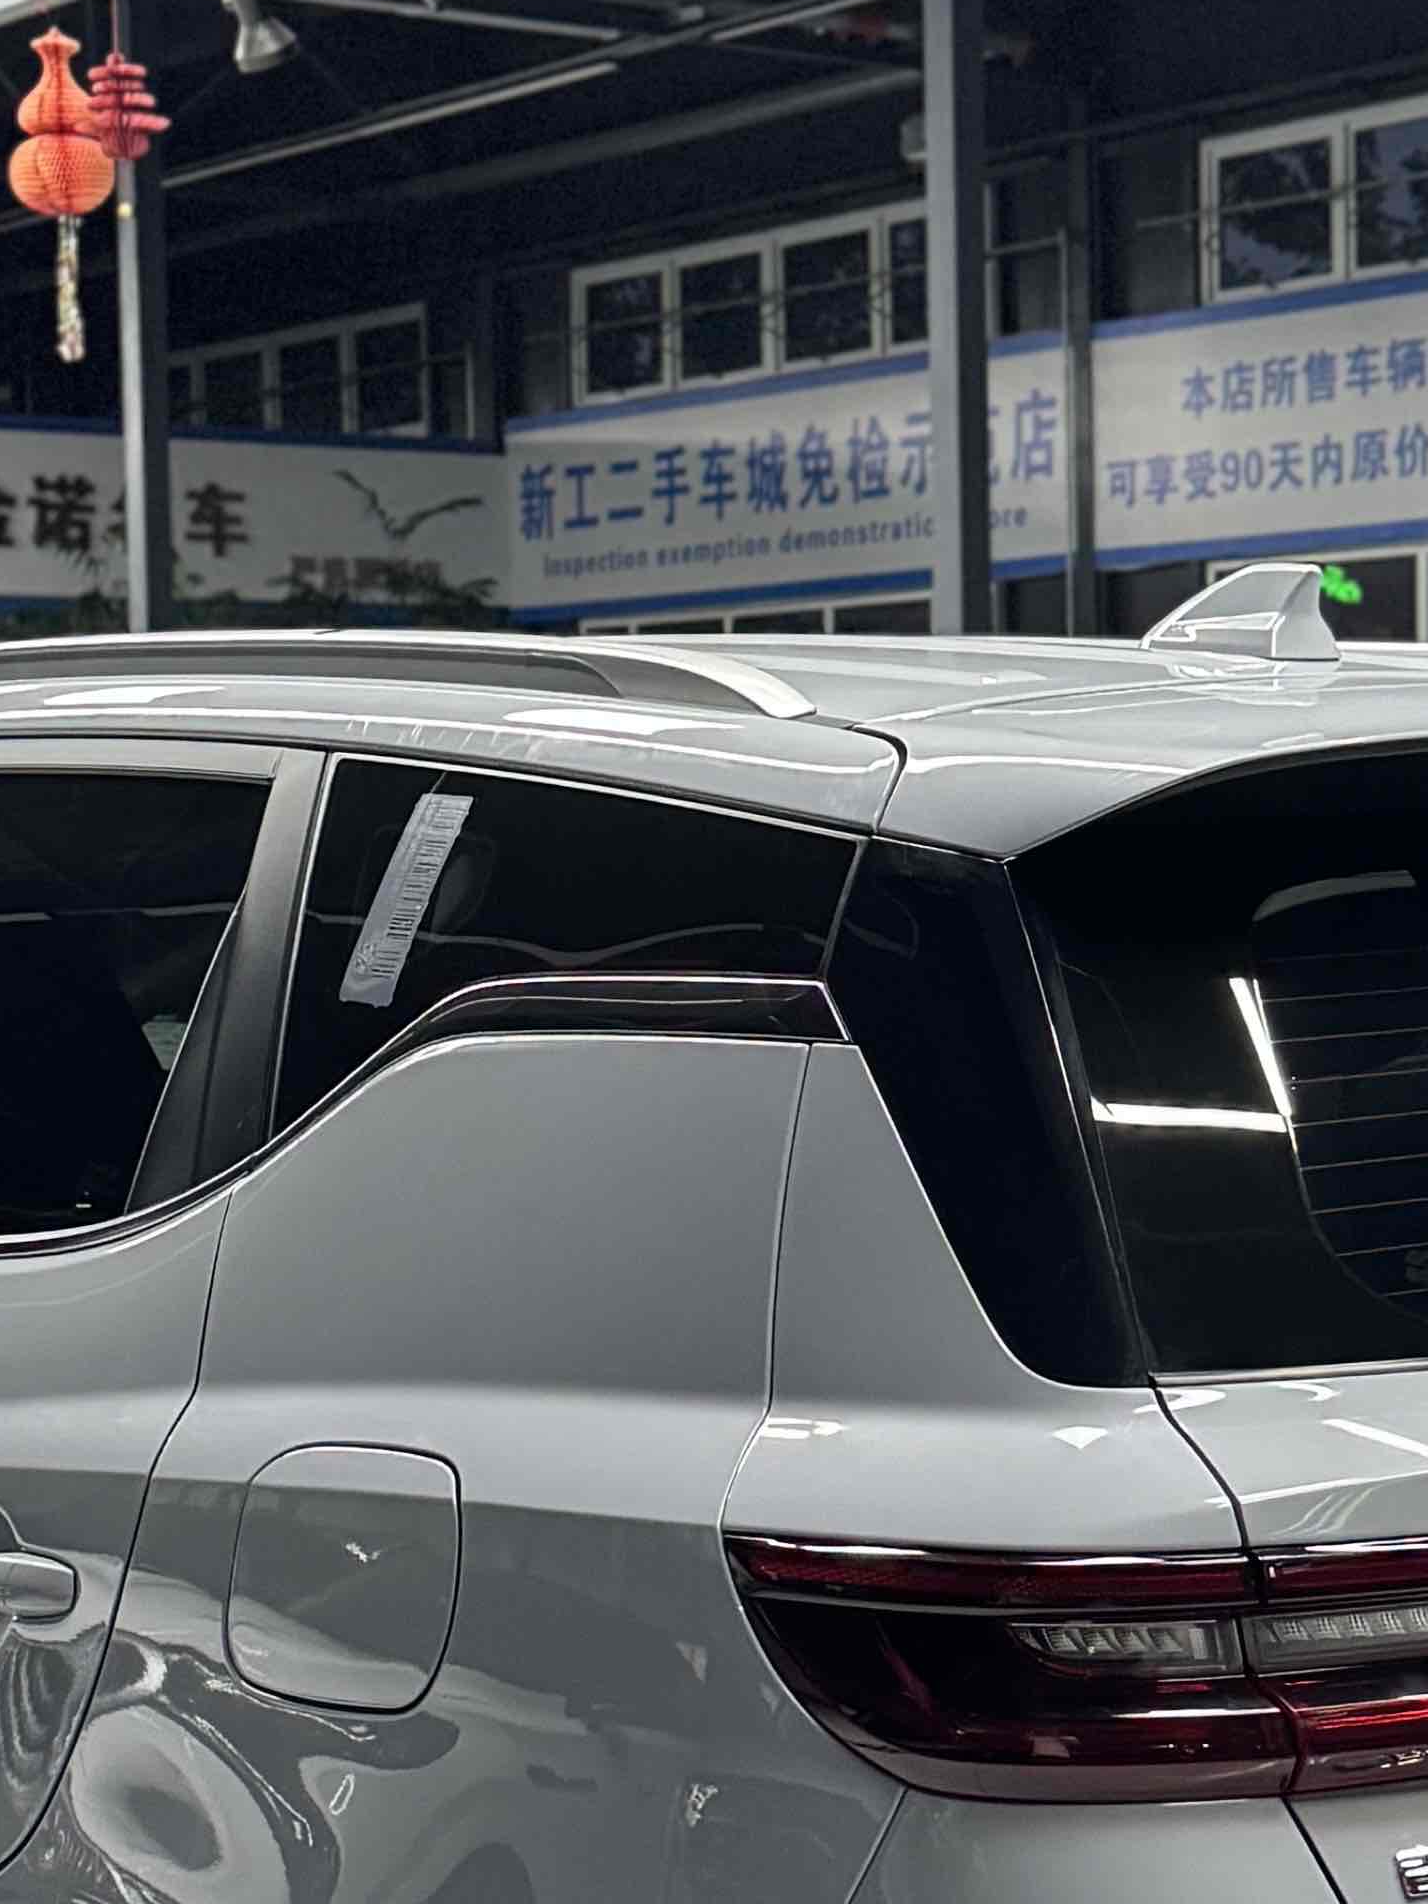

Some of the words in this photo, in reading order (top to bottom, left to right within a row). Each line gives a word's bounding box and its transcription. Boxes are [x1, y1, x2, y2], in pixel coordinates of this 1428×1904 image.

[518, 388, 1059, 542] 新工二手车城免检示店
[656, 533, 770, 567] exemption
